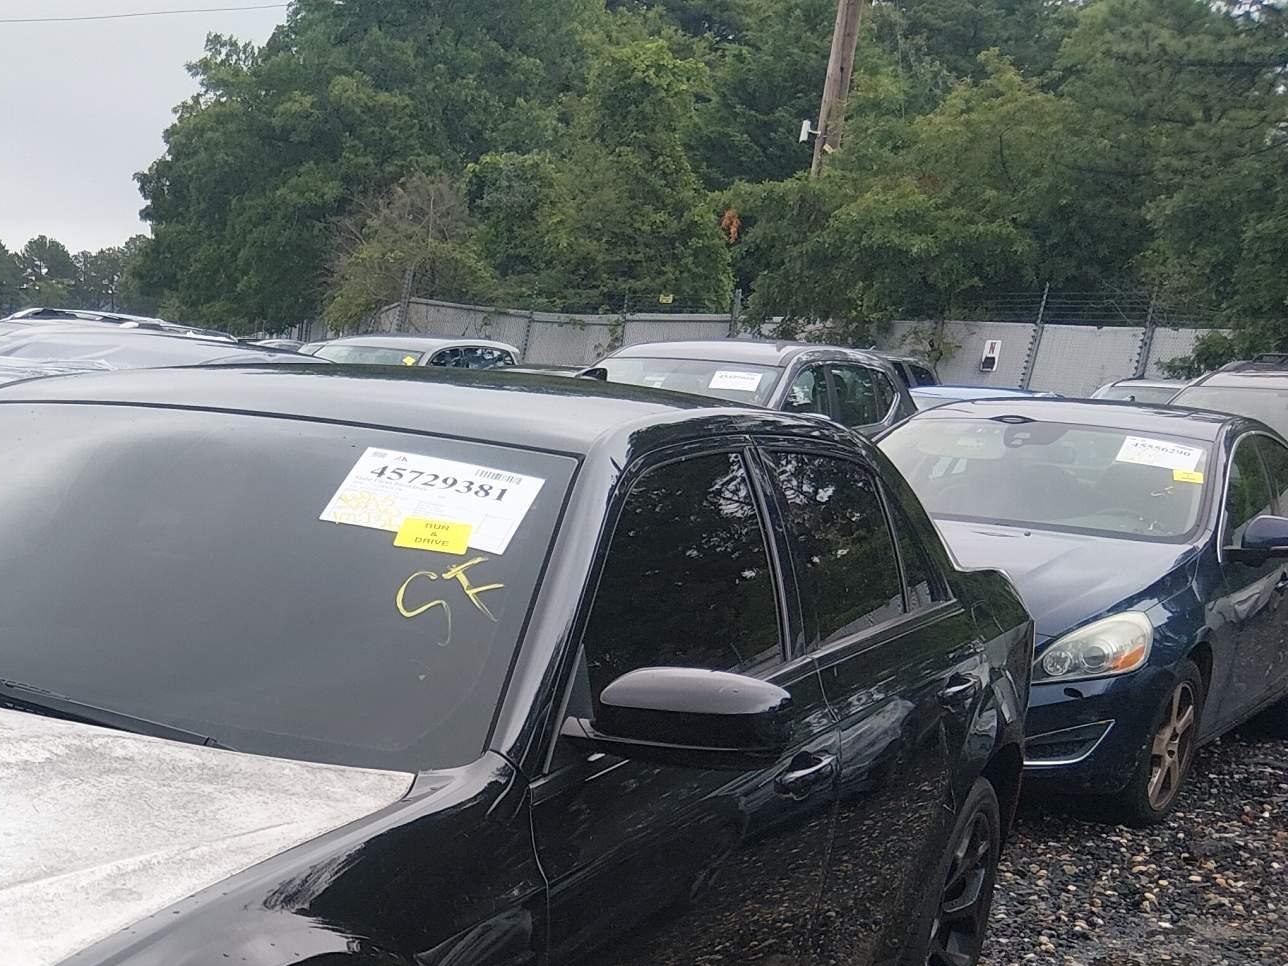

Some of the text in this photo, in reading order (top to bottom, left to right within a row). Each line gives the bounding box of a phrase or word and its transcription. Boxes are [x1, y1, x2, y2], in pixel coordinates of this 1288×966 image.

[370, 465, 508, 503] 45729381
[424, 522, 451, 531] RUN
[414, 536, 450, 547] DRIVE
